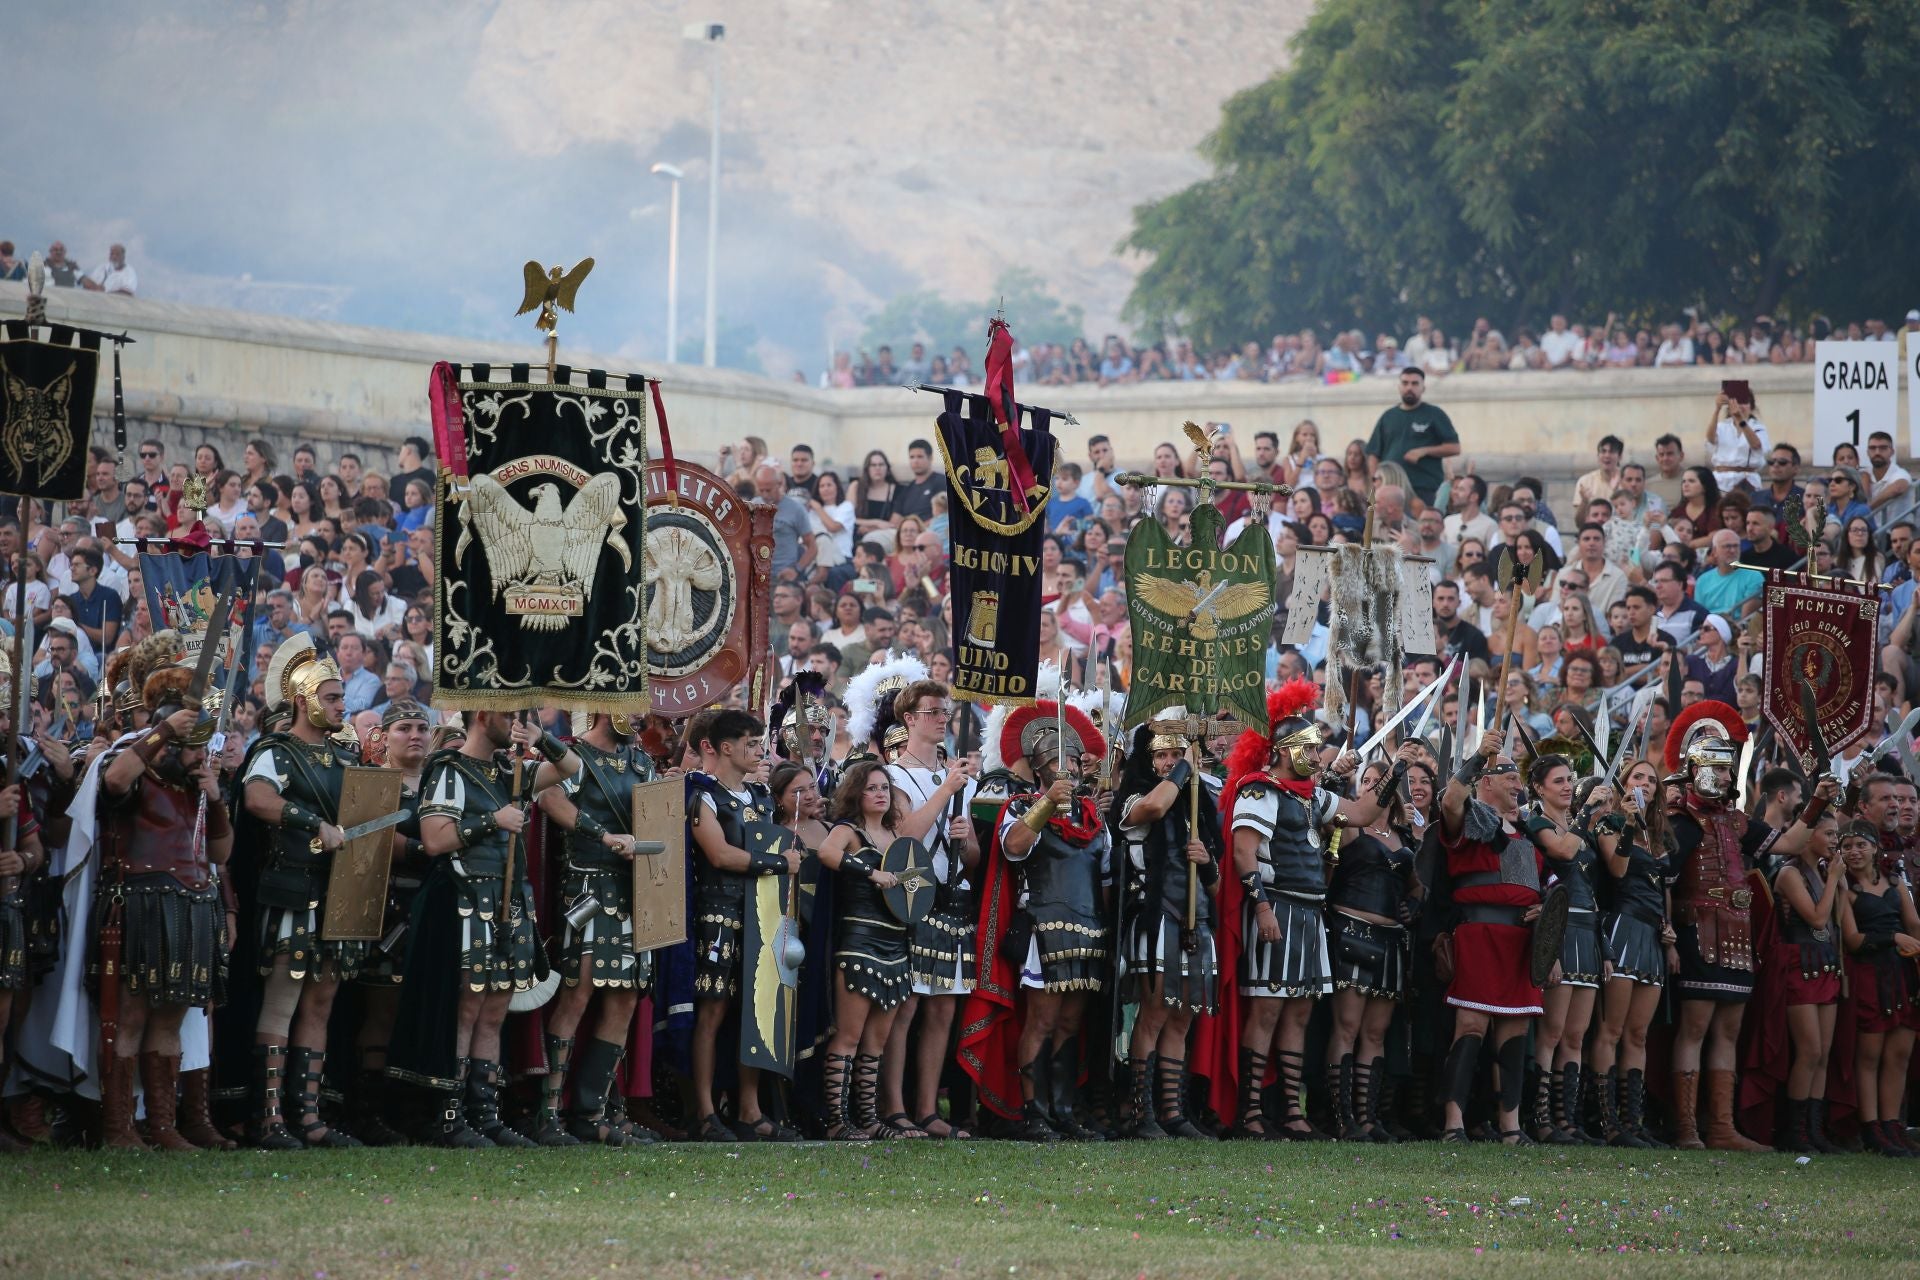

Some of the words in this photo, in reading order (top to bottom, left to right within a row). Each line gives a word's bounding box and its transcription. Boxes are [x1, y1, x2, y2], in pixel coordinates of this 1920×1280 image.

[1823, 361, 1888, 390] GRADA
[1845, 409, 1860, 446] 1
[498, 460, 530, 482] GENS
[534, 459, 587, 486] NUMISIUS
[1146, 548, 1261, 575] LEGION
[515, 597, 576, 611] MCMXCII
[1795, 599, 1845, 616] MCMXC
[1131, 598, 1174, 634] CUESTOR
[1217, 626, 1238, 639] CAYO
[1239, 603, 1275, 634] FLAMINIO
[1140, 631, 1262, 660] REHENES
[1818, 620, 1852, 648] ROMANA
[1137, 667, 1262, 695] CARTHAGO
[1190, 659, 1217, 677] DE
